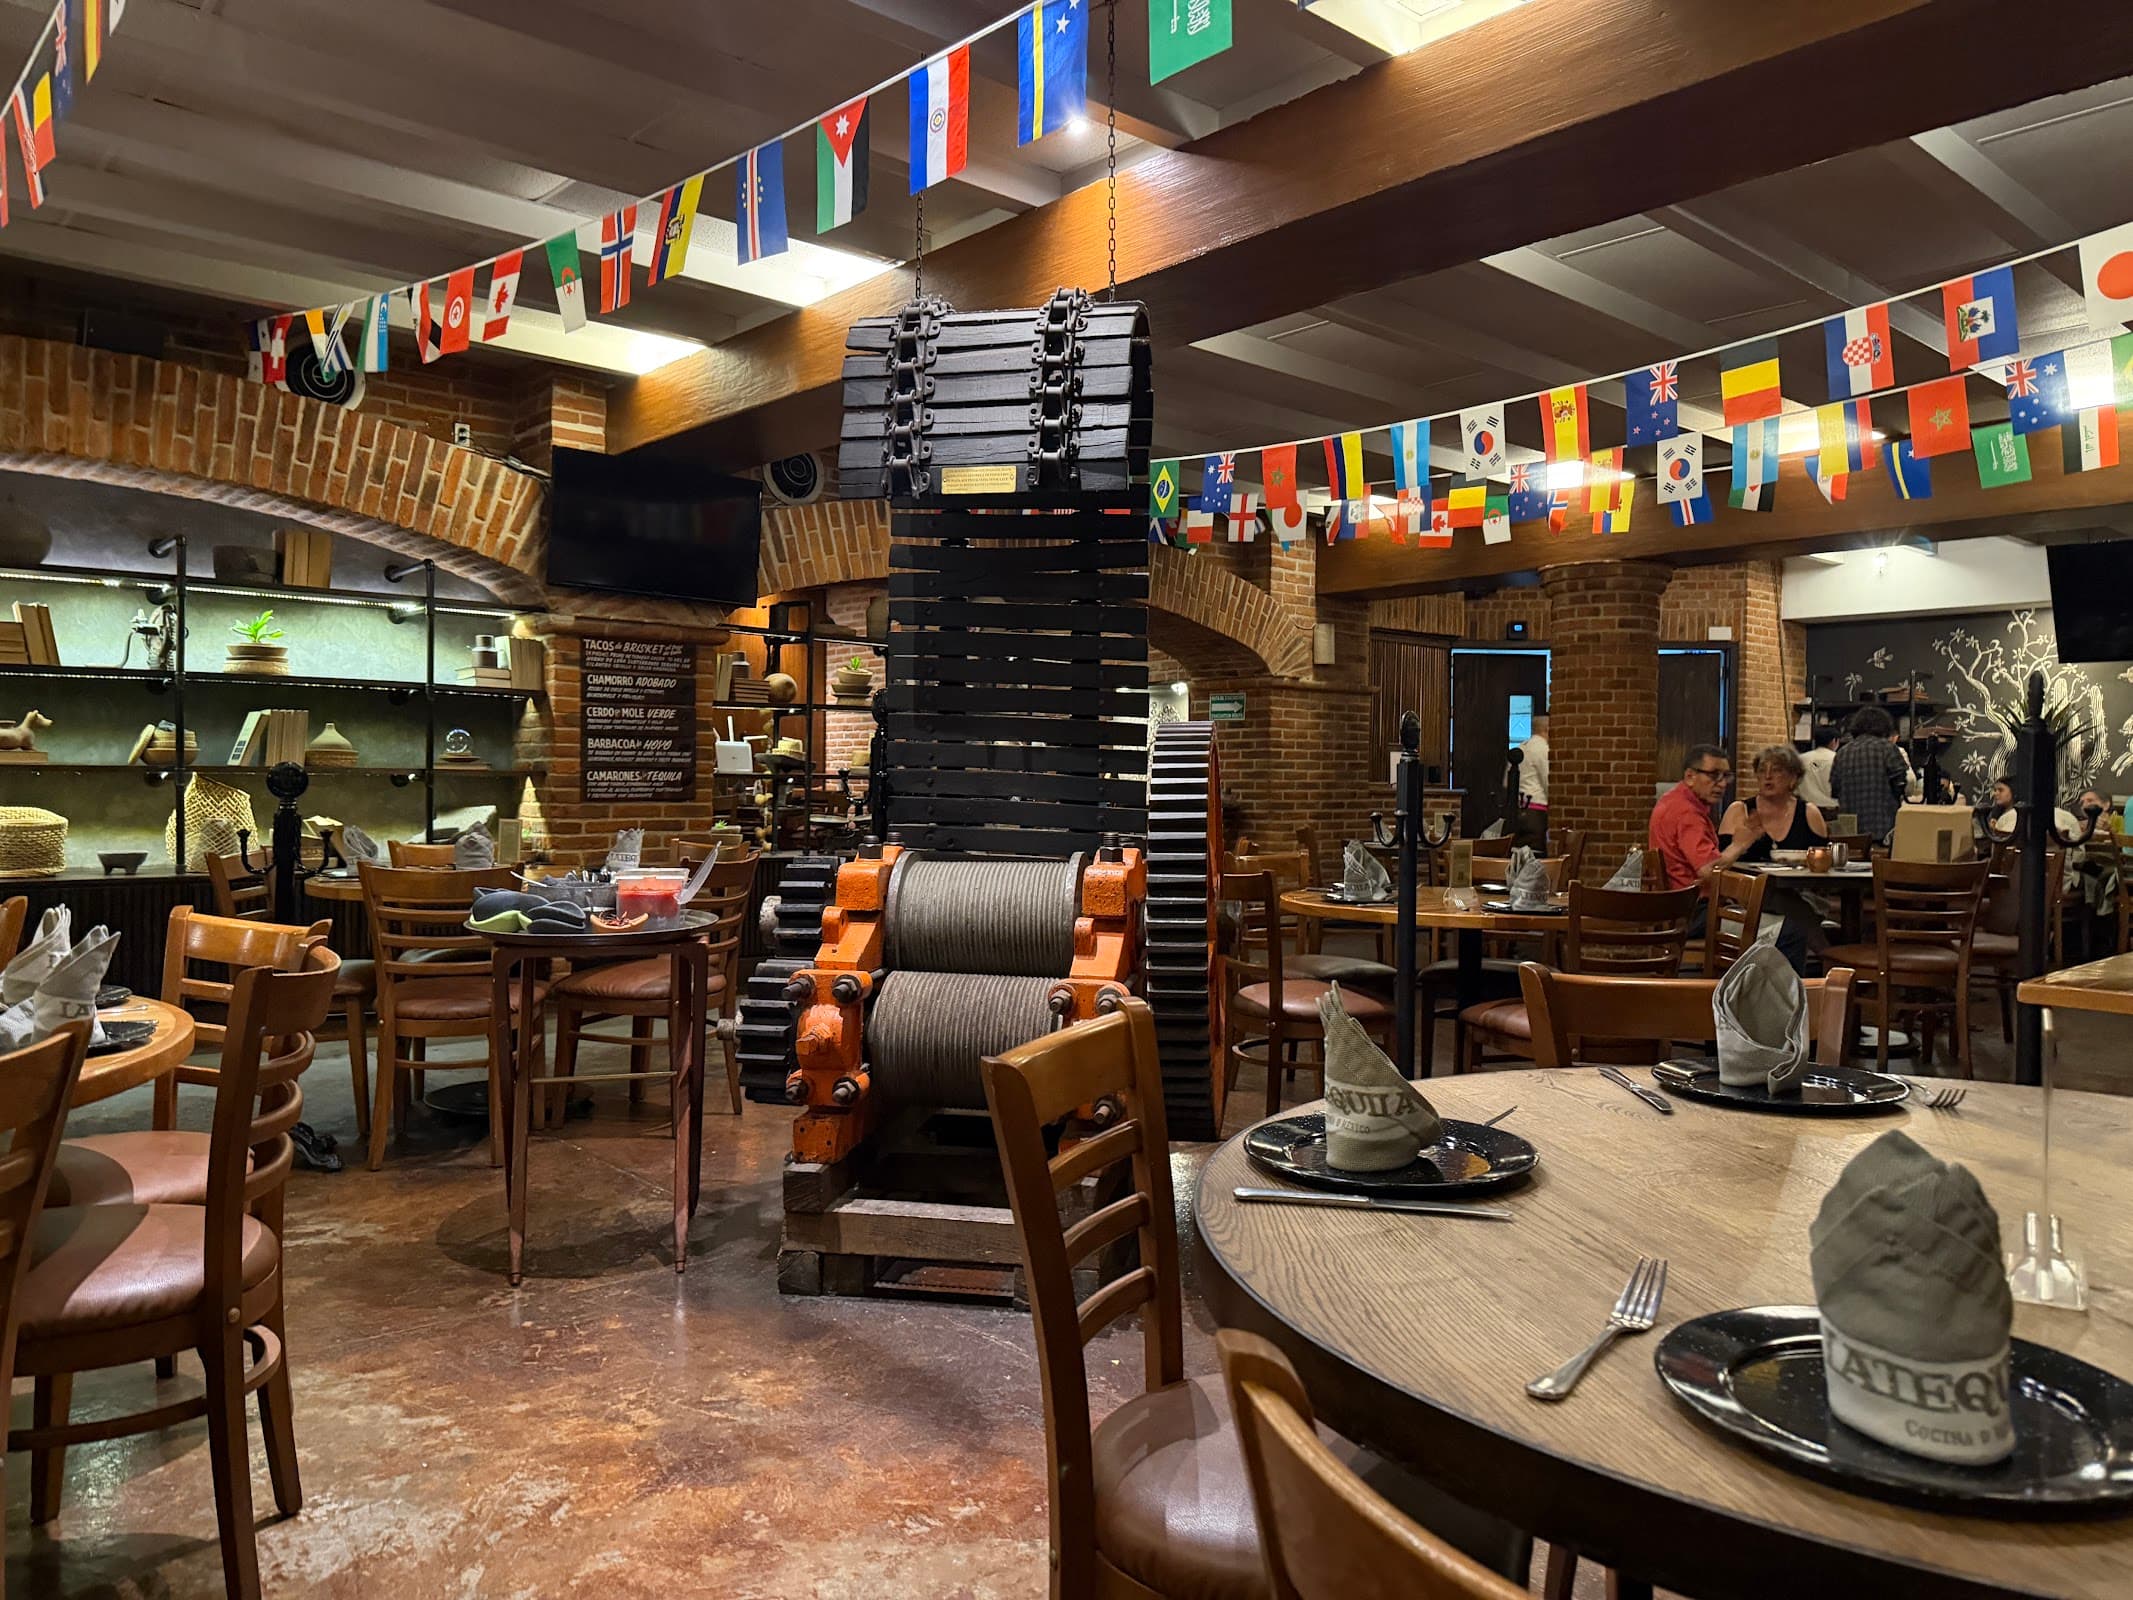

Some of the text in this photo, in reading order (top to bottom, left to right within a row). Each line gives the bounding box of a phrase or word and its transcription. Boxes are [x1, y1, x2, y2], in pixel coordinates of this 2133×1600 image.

[583, 639, 615, 651] TACOS
[622, 642, 665, 655] BRISKET
[587, 674, 677, 689] CHAMORRO ADOBADO
[586, 706, 615, 718] CERDO
[621, 708, 644, 719] MOLE
[646, 709, 677, 720] VERDE
[587, 738, 636, 750] BARBACOA
[642, 740, 673, 751] HOYO
[586, 770, 640, 782] CAMARONES
[646, 770, 682, 782] TEQUILA
